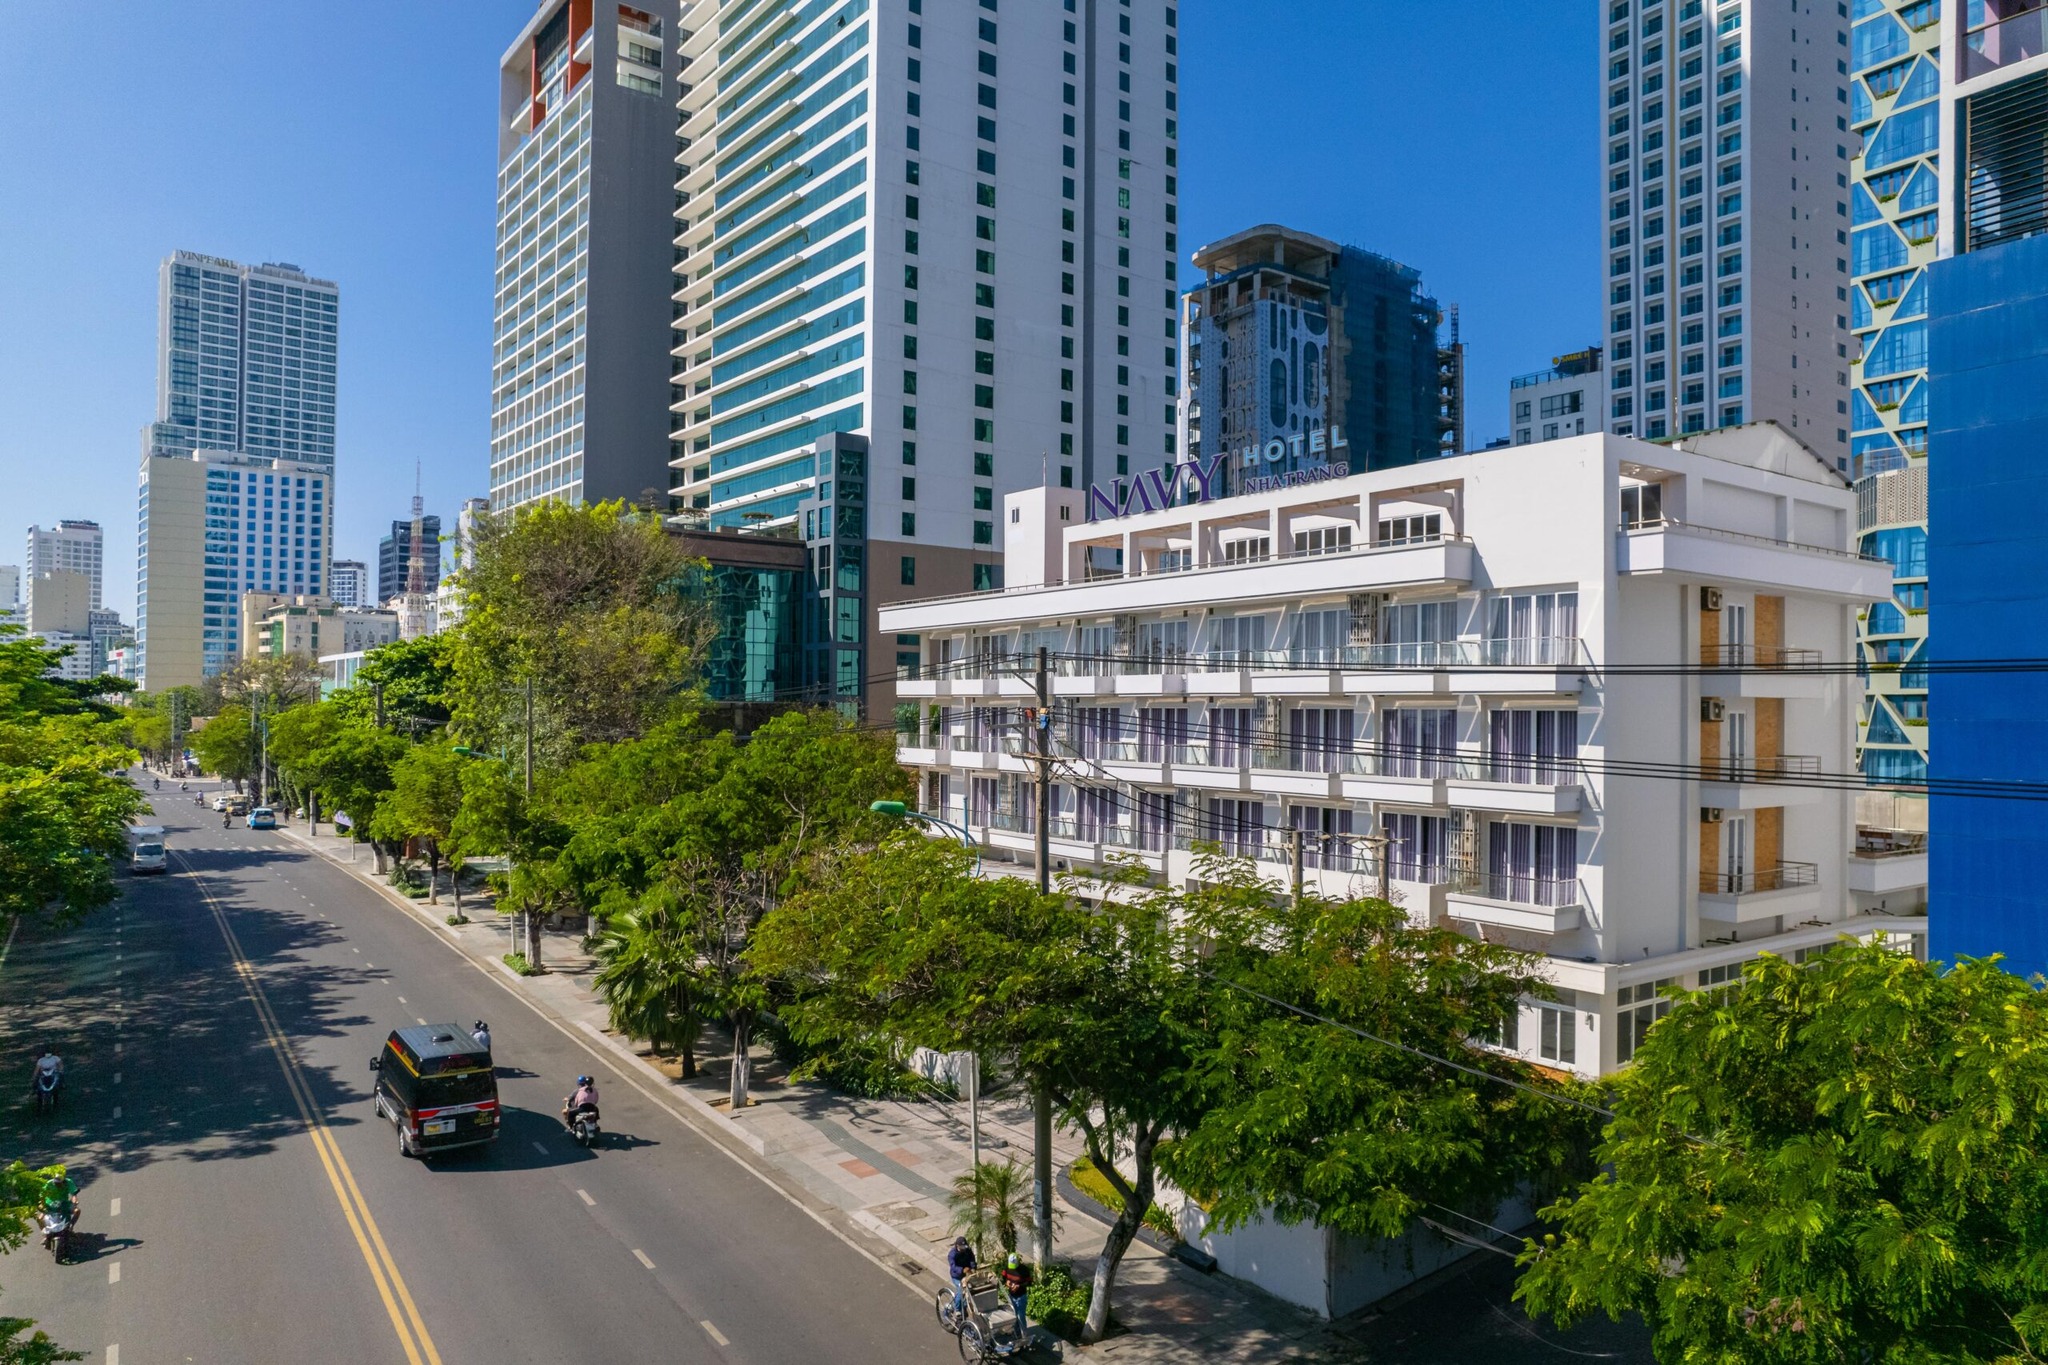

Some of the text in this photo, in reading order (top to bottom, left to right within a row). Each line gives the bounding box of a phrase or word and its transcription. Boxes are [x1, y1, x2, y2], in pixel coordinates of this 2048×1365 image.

[180, 249, 239, 270] VINPEARL
[1243, 425, 1348, 467] HOTEL
[1089, 452, 1228, 522] NAVY
